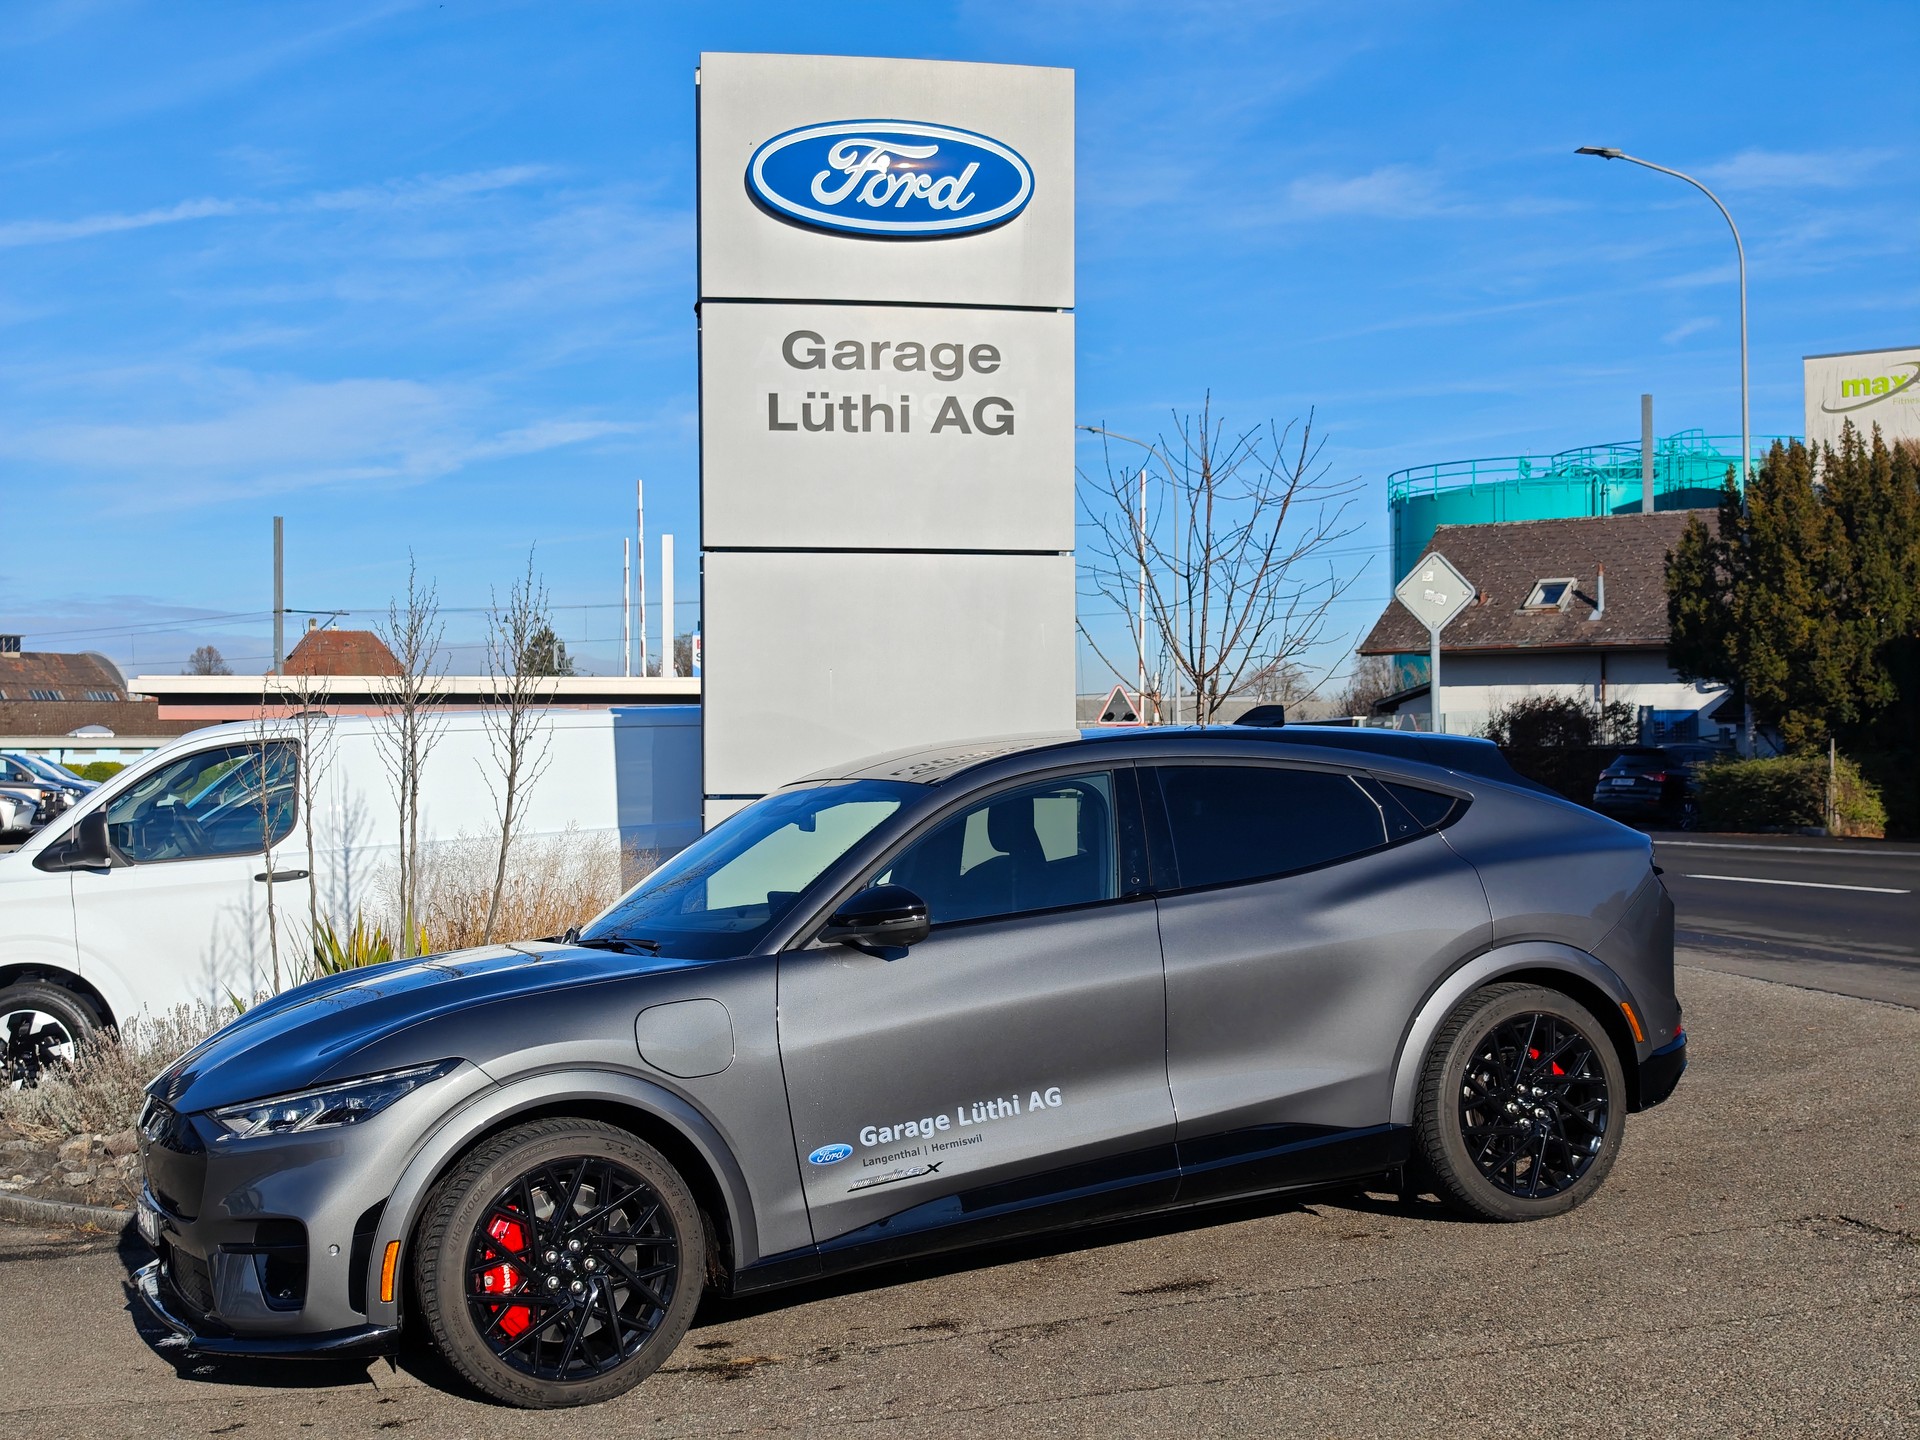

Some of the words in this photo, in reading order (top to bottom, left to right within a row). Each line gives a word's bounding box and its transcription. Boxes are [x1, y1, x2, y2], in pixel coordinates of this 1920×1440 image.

[811, 138, 980, 211] Ford
[781, 329, 1002, 382] Garage
[768, 391, 910, 433] Lüthi
[930, 395, 1015, 435] AG
[859, 1113, 951, 1147] Garage
[957, 1094, 1021, 1127] Lüthi
[1028, 1086, 1063, 1113] AG
[816, 1146, 845, 1163] Ford
[862, 1147, 921, 1168] Langenthal
[931, 1134, 983, 1153] Hermiswil
